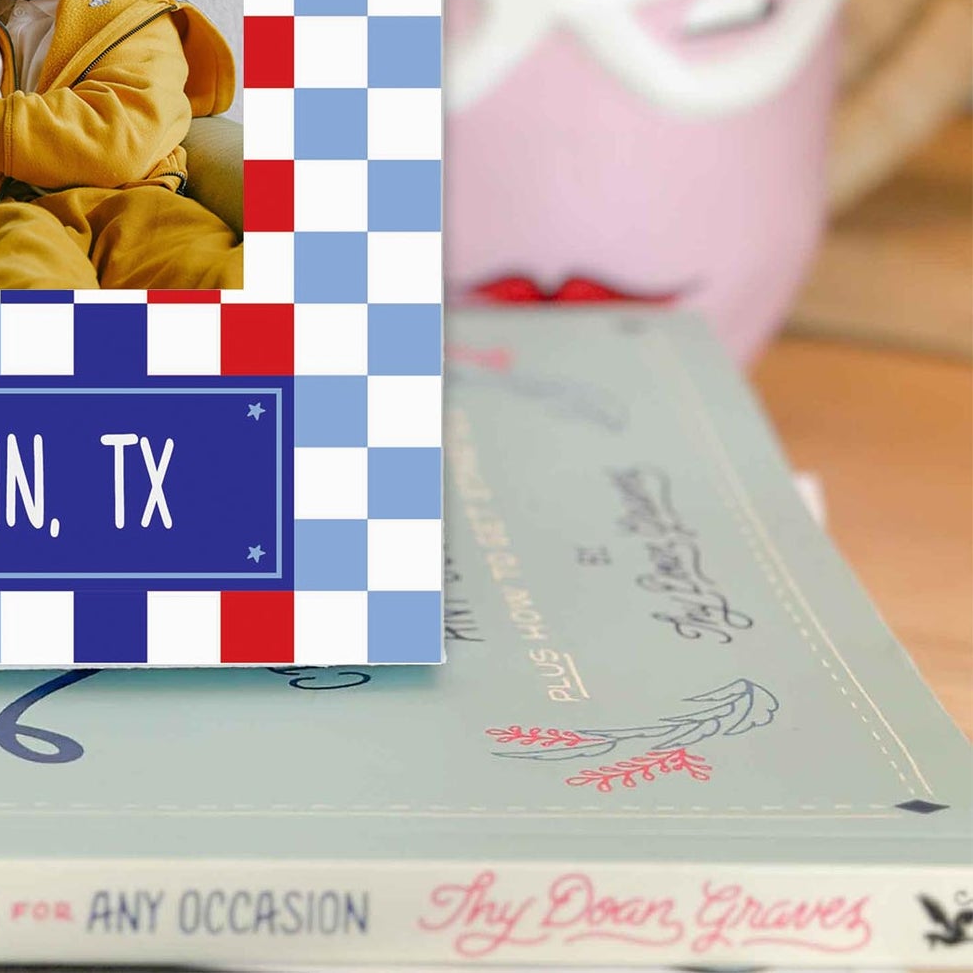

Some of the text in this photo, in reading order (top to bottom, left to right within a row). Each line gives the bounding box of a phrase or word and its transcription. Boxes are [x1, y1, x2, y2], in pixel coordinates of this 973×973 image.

[100, 432, 175, 529] TX
[502, 585, 548, 642] HOW
[529, 647, 581, 703] PLUS
[10, 900, 73, 922] FOR
[86, 890, 166, 935] ANY
[177, 890, 370, 936] OCCASION
[417, 870, 872, 957] Thy Doan Graves
